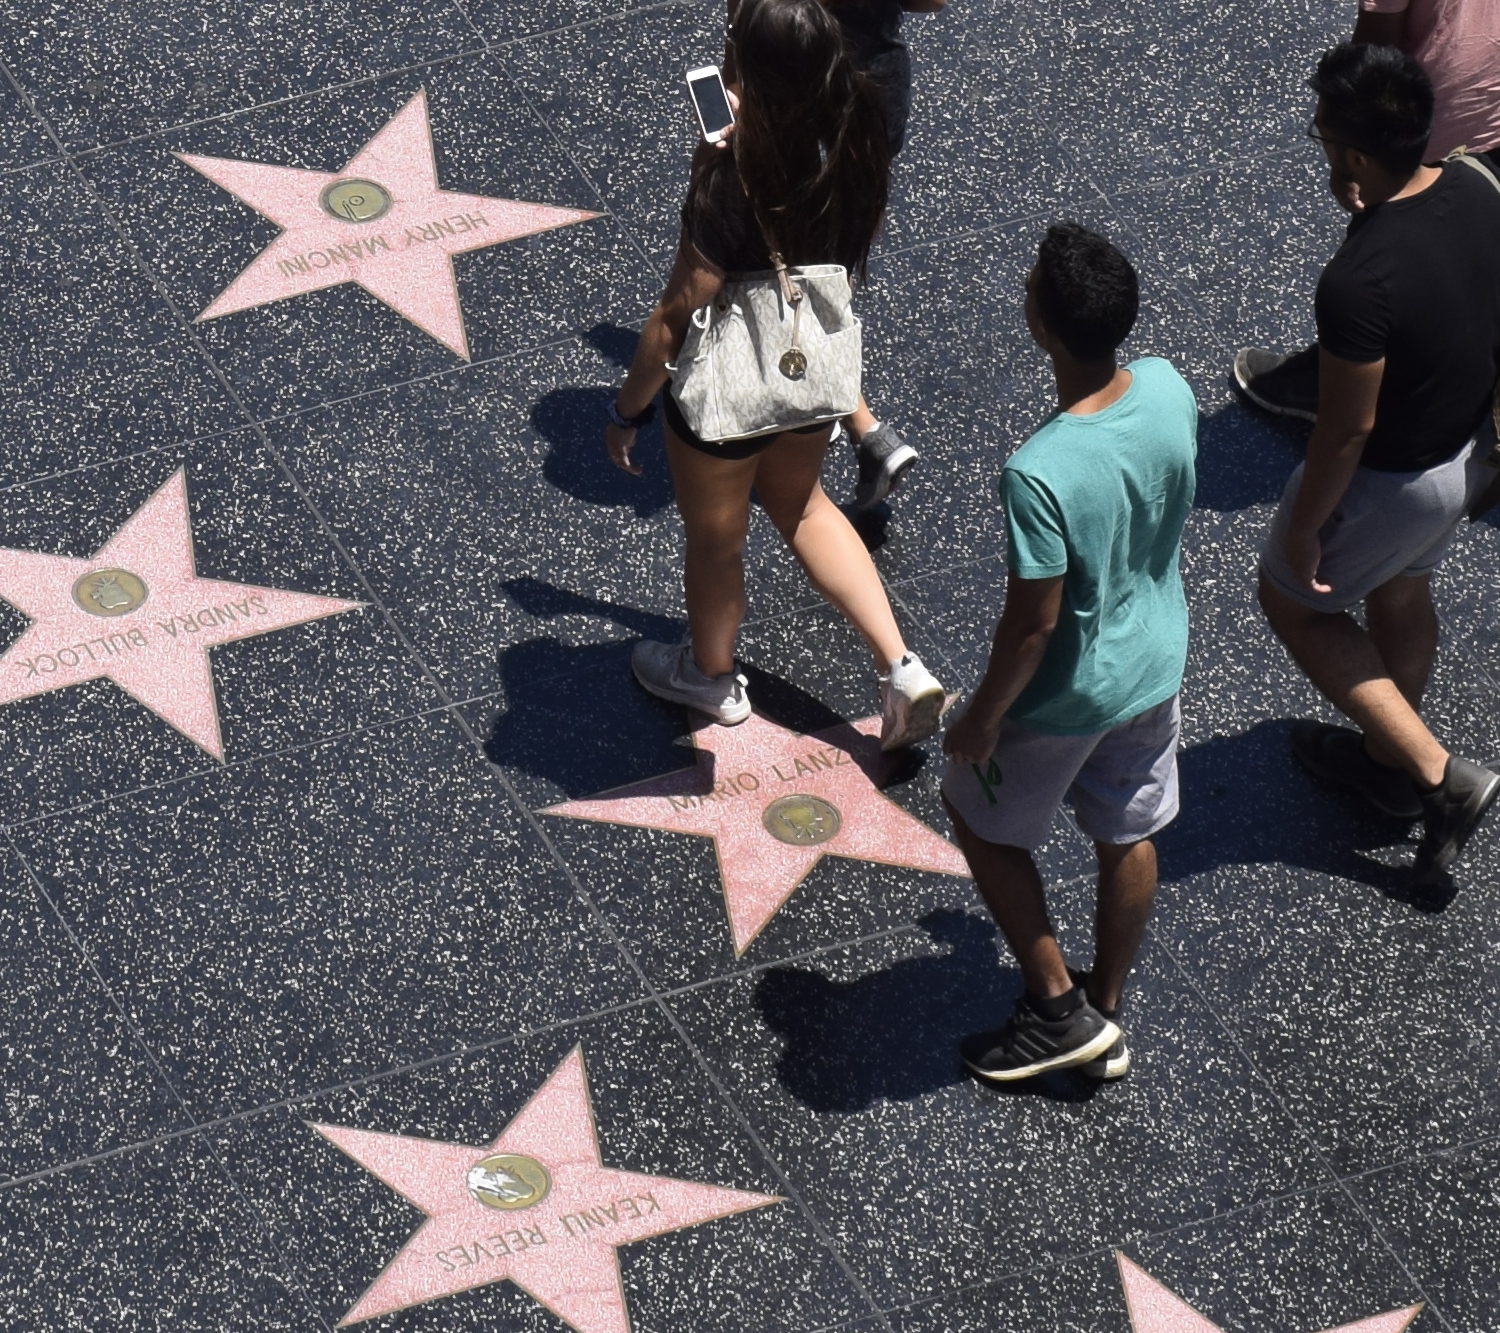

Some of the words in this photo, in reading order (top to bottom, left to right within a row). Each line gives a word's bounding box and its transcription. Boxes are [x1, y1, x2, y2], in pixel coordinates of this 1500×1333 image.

[405, 210, 490, 247] HENRY
[276, 235, 391, 278] MANCINI
[157, 594, 269, 640] SANDRA
[15, 631, 147, 679] BULLOCK
[666, 772, 761, 814] MARIO
[771, 745, 862, 783] LANZ
[559, 1190, 661, 1236] KEANU
[436, 1224, 547, 1274] REEVES
